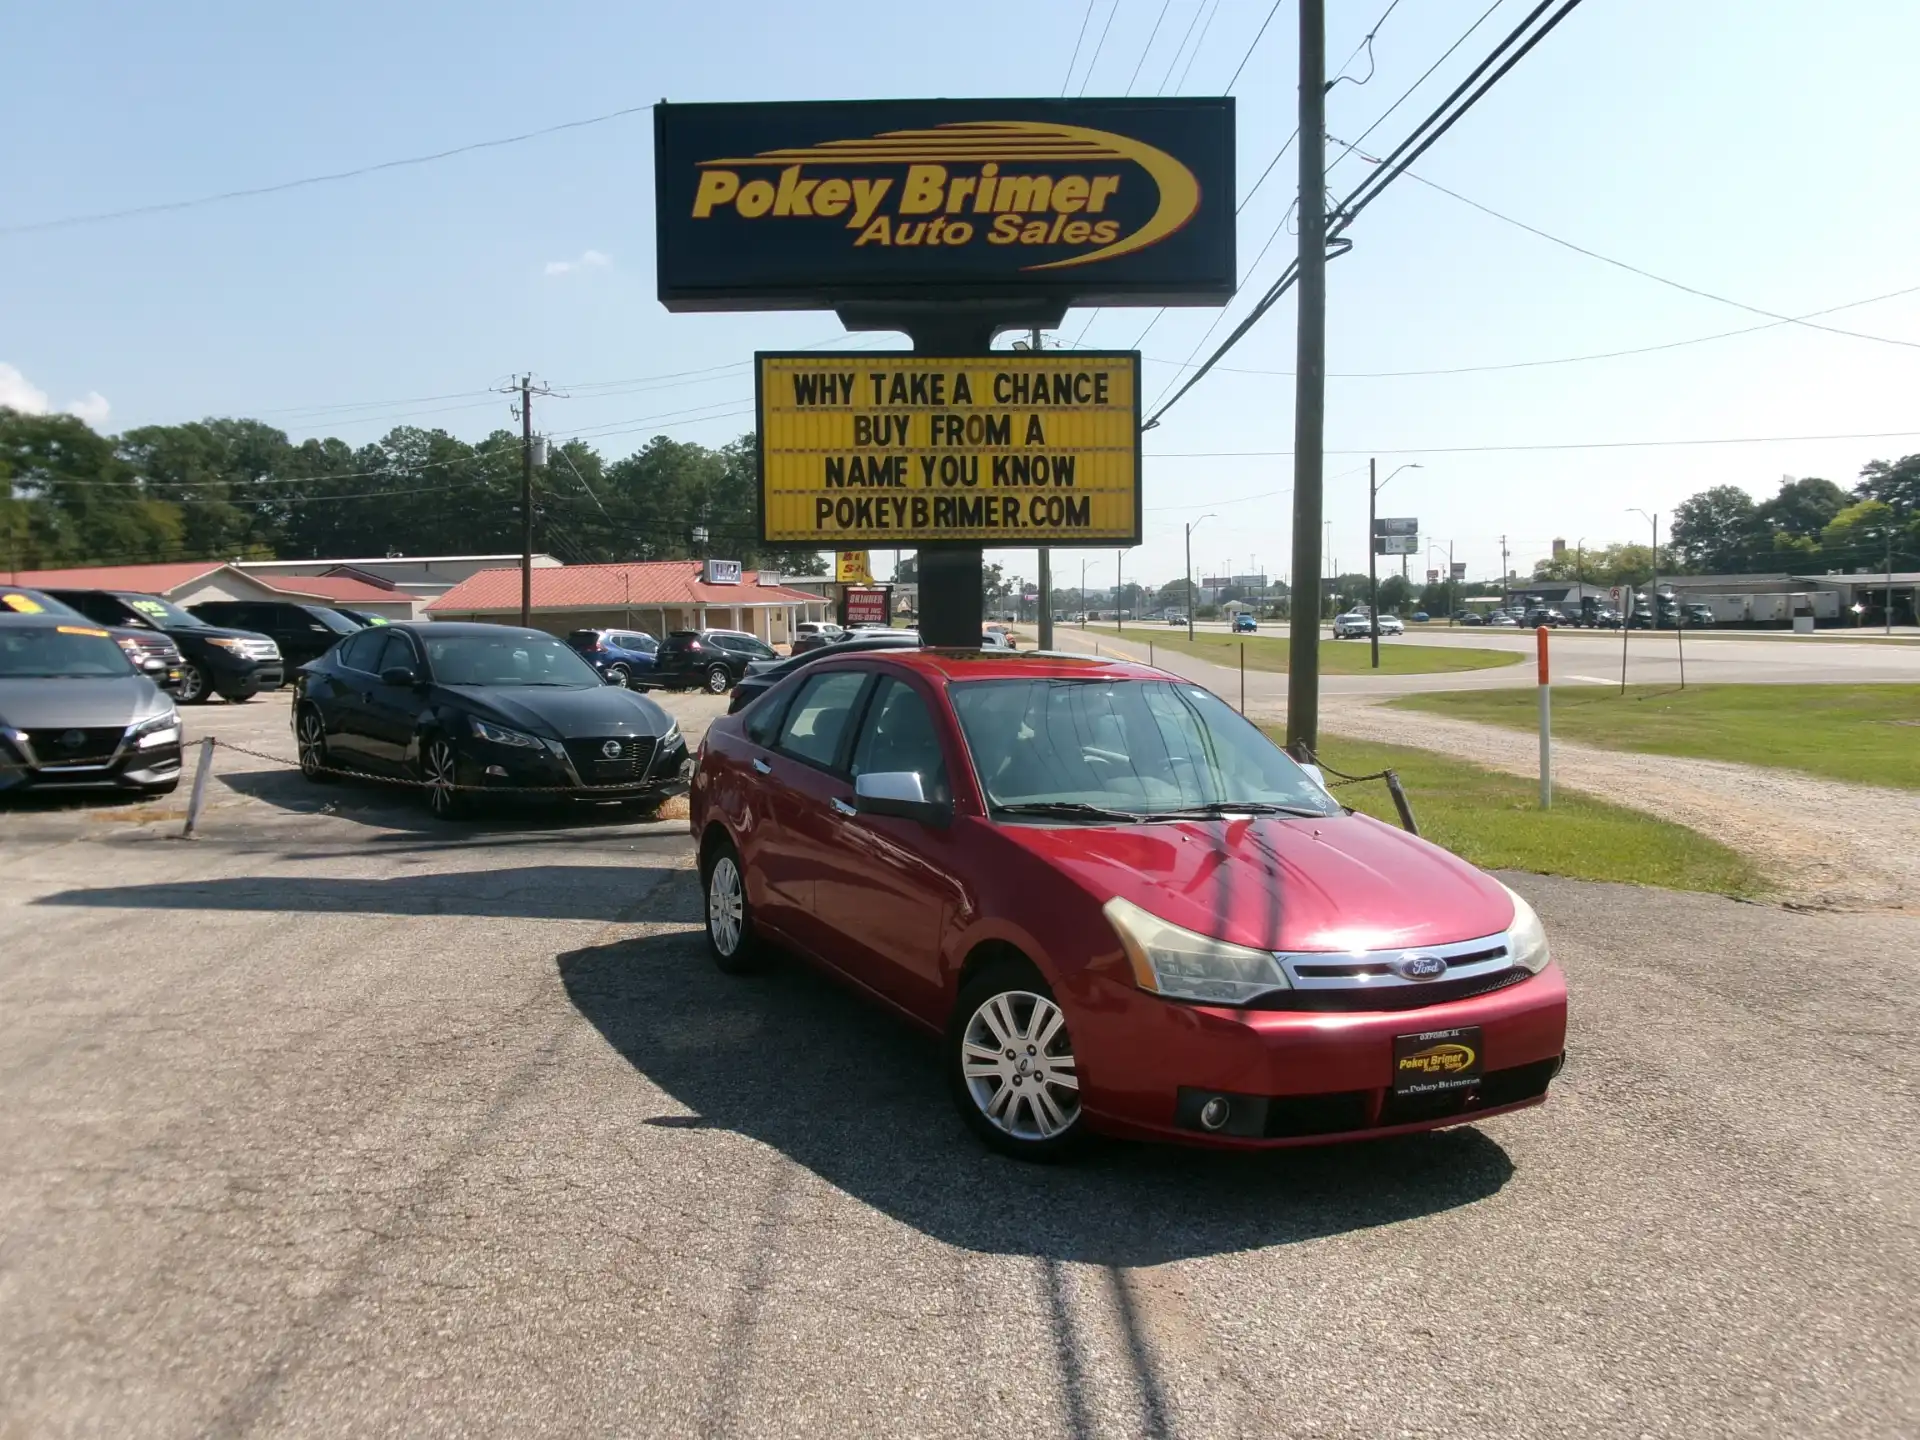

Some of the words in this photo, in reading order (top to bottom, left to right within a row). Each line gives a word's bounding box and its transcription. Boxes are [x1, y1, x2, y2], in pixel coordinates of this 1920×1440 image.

[691, 164, 894, 229] Pokey
[899, 161, 1120, 214] Brimer
[853, 214, 974, 246] Auto
[986, 213, 1120, 244] Sales
[793, 373, 855, 406] WHY
[869, 373, 946, 405] TAKE
[952, 373, 973, 405] A
[993, 372, 1109, 404] CHANCE
[854, 415, 910, 446] BUY
[930, 414, 1011, 446] FROM
[1024, 414, 1045, 446] A
[825, 456, 908, 488] NAME
[920, 456, 979, 487] YOU
[992, 456, 1076, 487] KNOW
[816, 496, 1090, 529] POKEYBRIMER.COM
[1412, 959, 1439, 975] Ford
[1400, 1057, 1429, 1069] Pokey
[1431, 1053, 1462, 1064] Brimer
